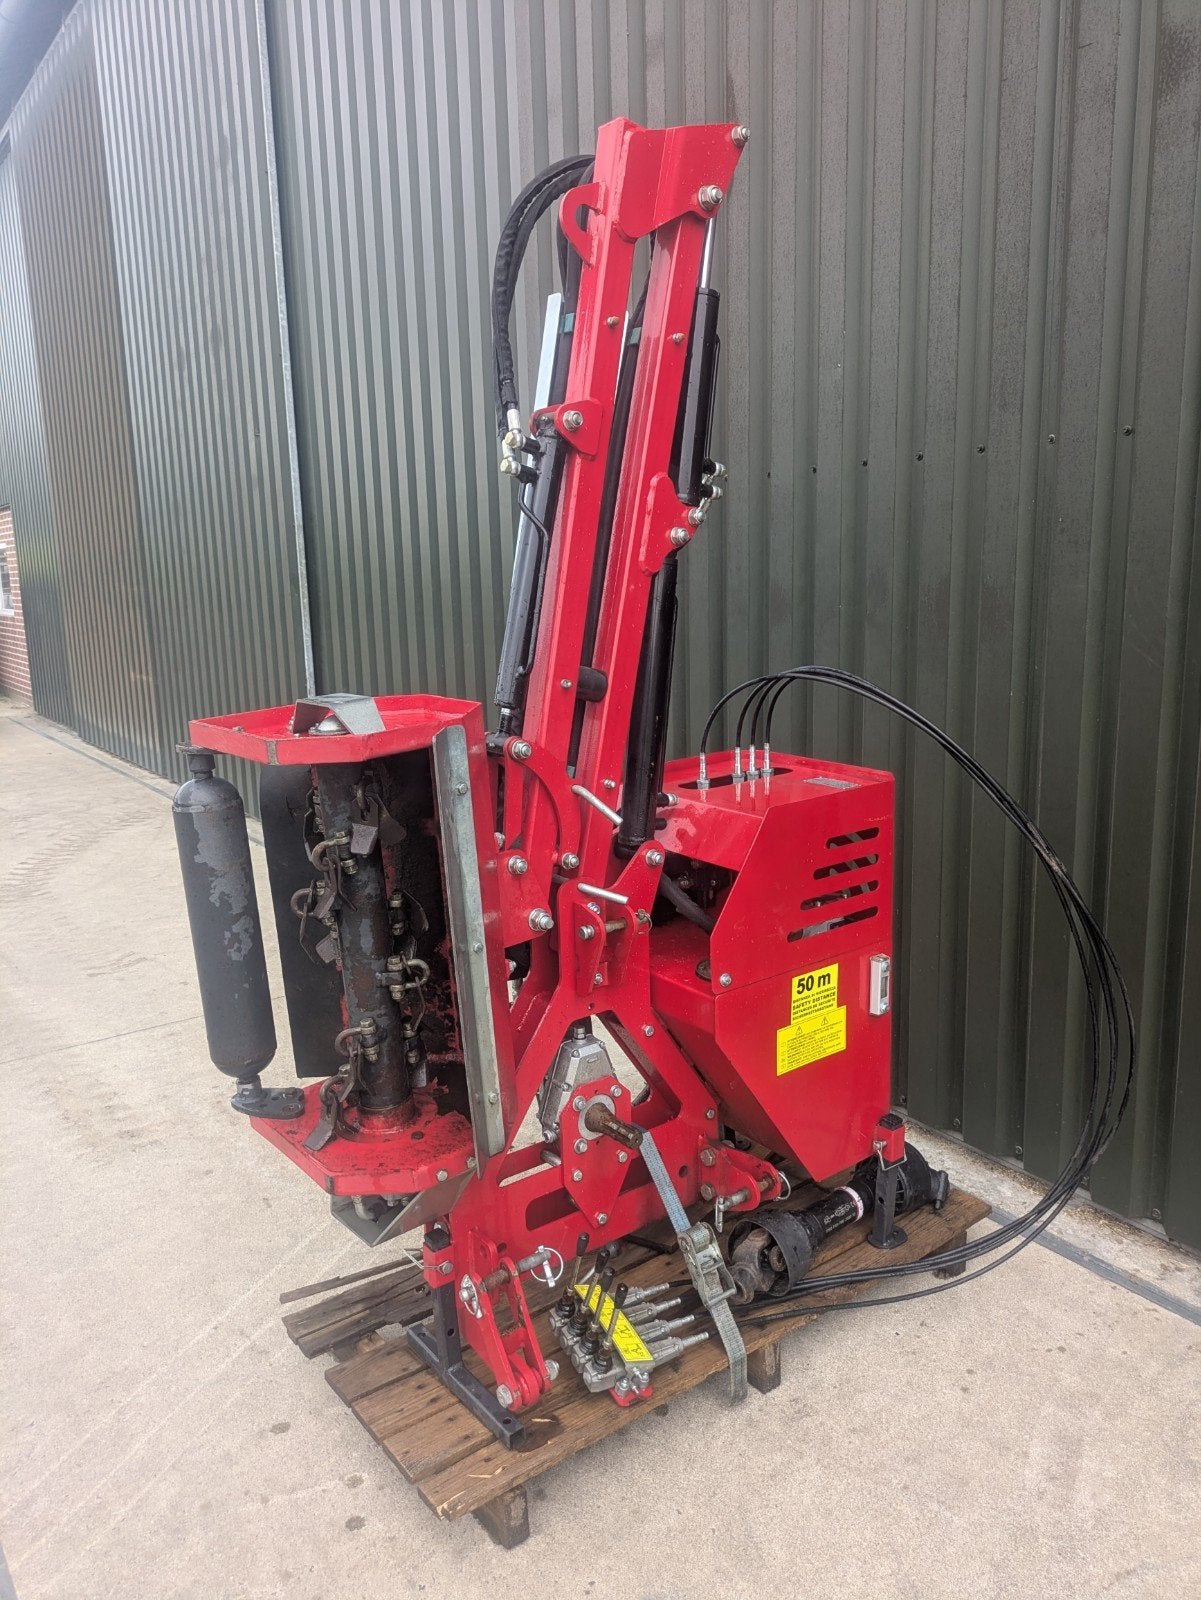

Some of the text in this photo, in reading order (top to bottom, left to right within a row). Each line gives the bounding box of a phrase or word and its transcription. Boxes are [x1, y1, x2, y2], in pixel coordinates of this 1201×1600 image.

[797, 973, 830, 994] 50 m
[793, 992, 835, 1010] SAFETY DISTANCE
